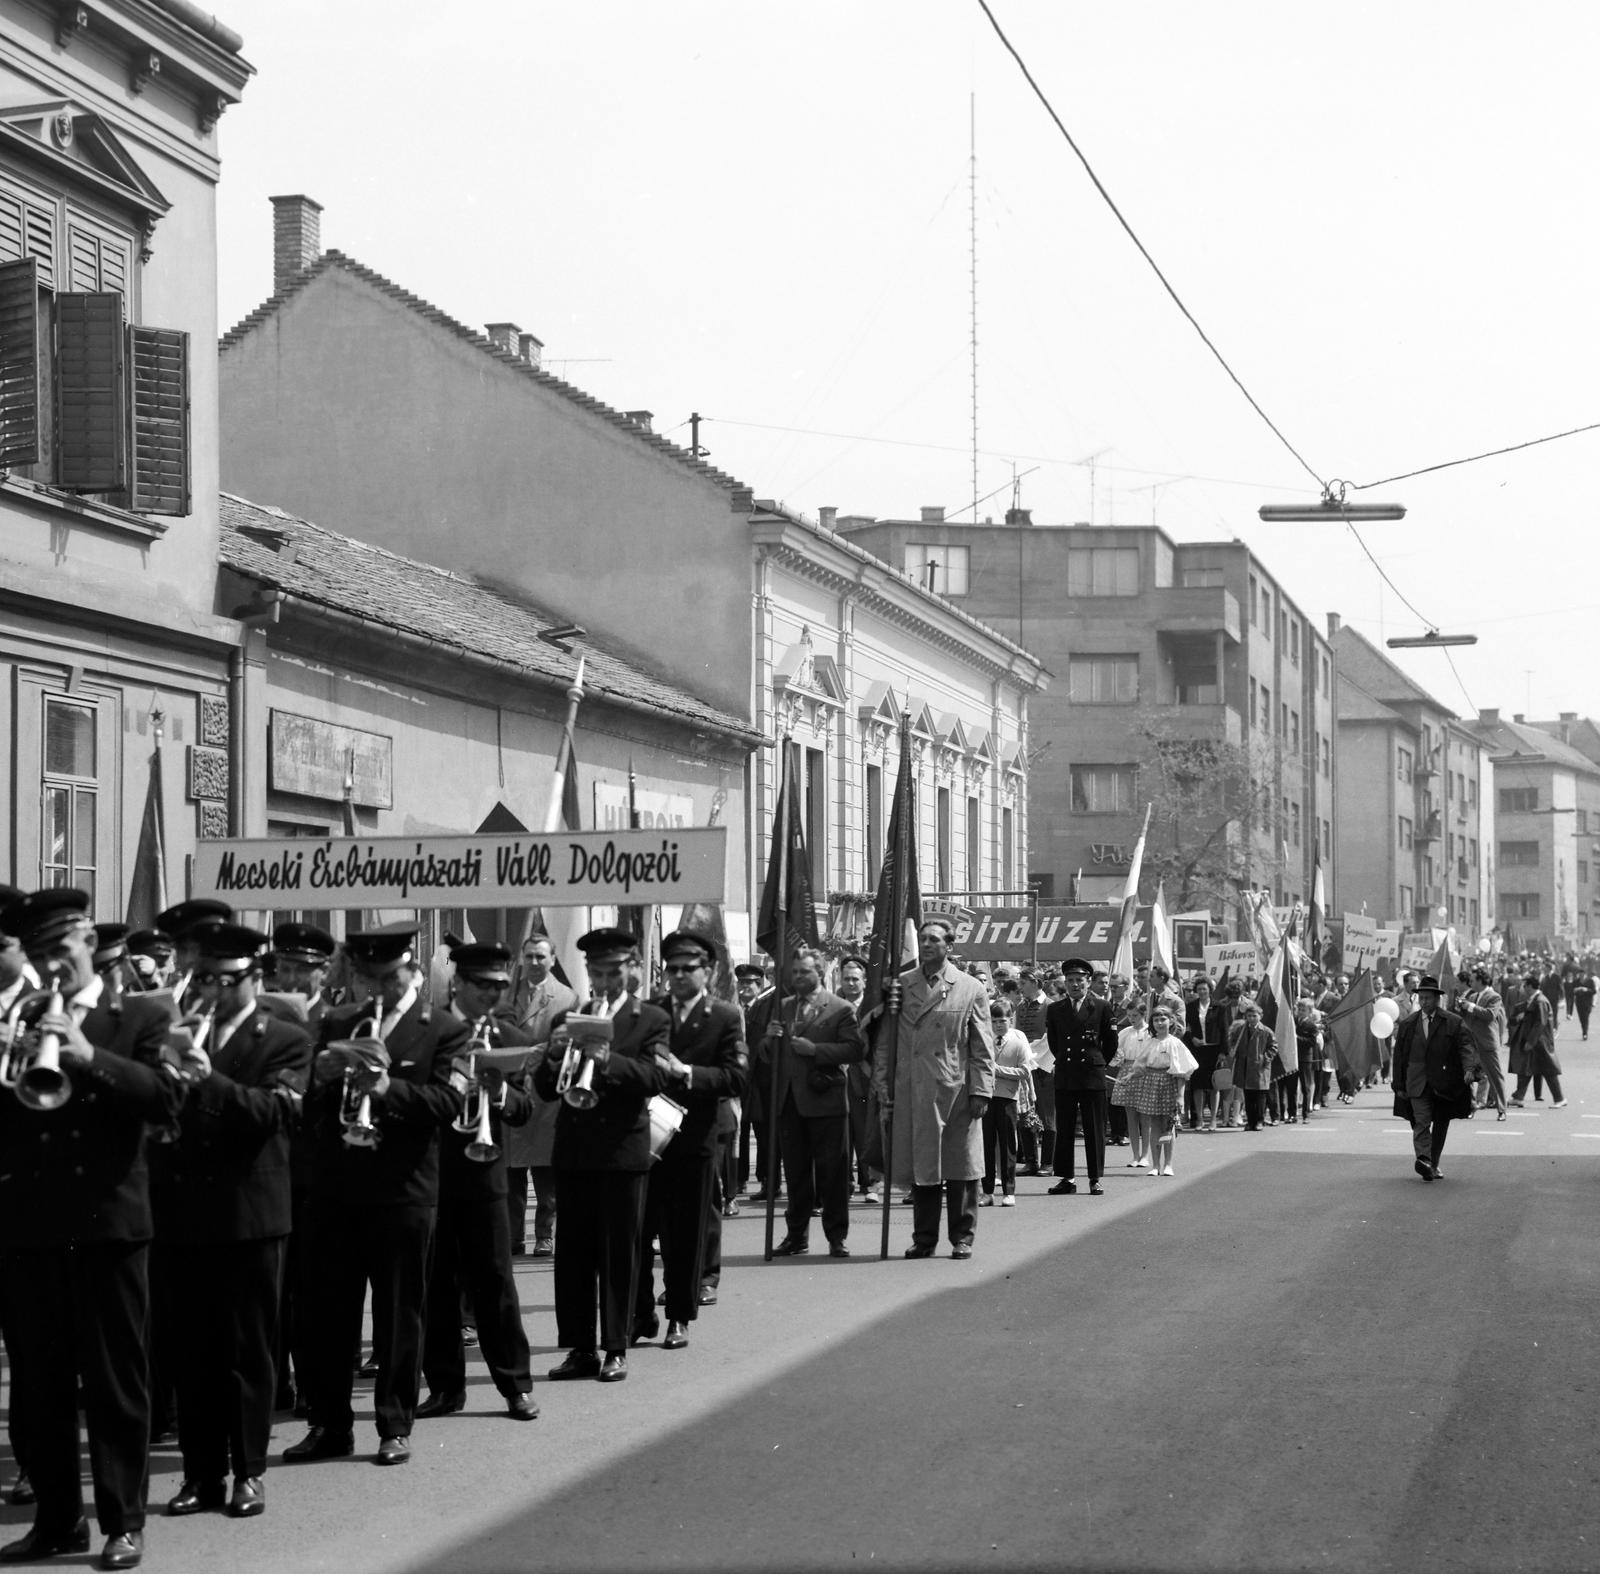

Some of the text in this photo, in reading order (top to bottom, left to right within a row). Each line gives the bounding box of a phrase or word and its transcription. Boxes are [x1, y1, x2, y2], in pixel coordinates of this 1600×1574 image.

[215, 839, 682, 899] Mecseki Ércbányászati Váll. Dolgozói
